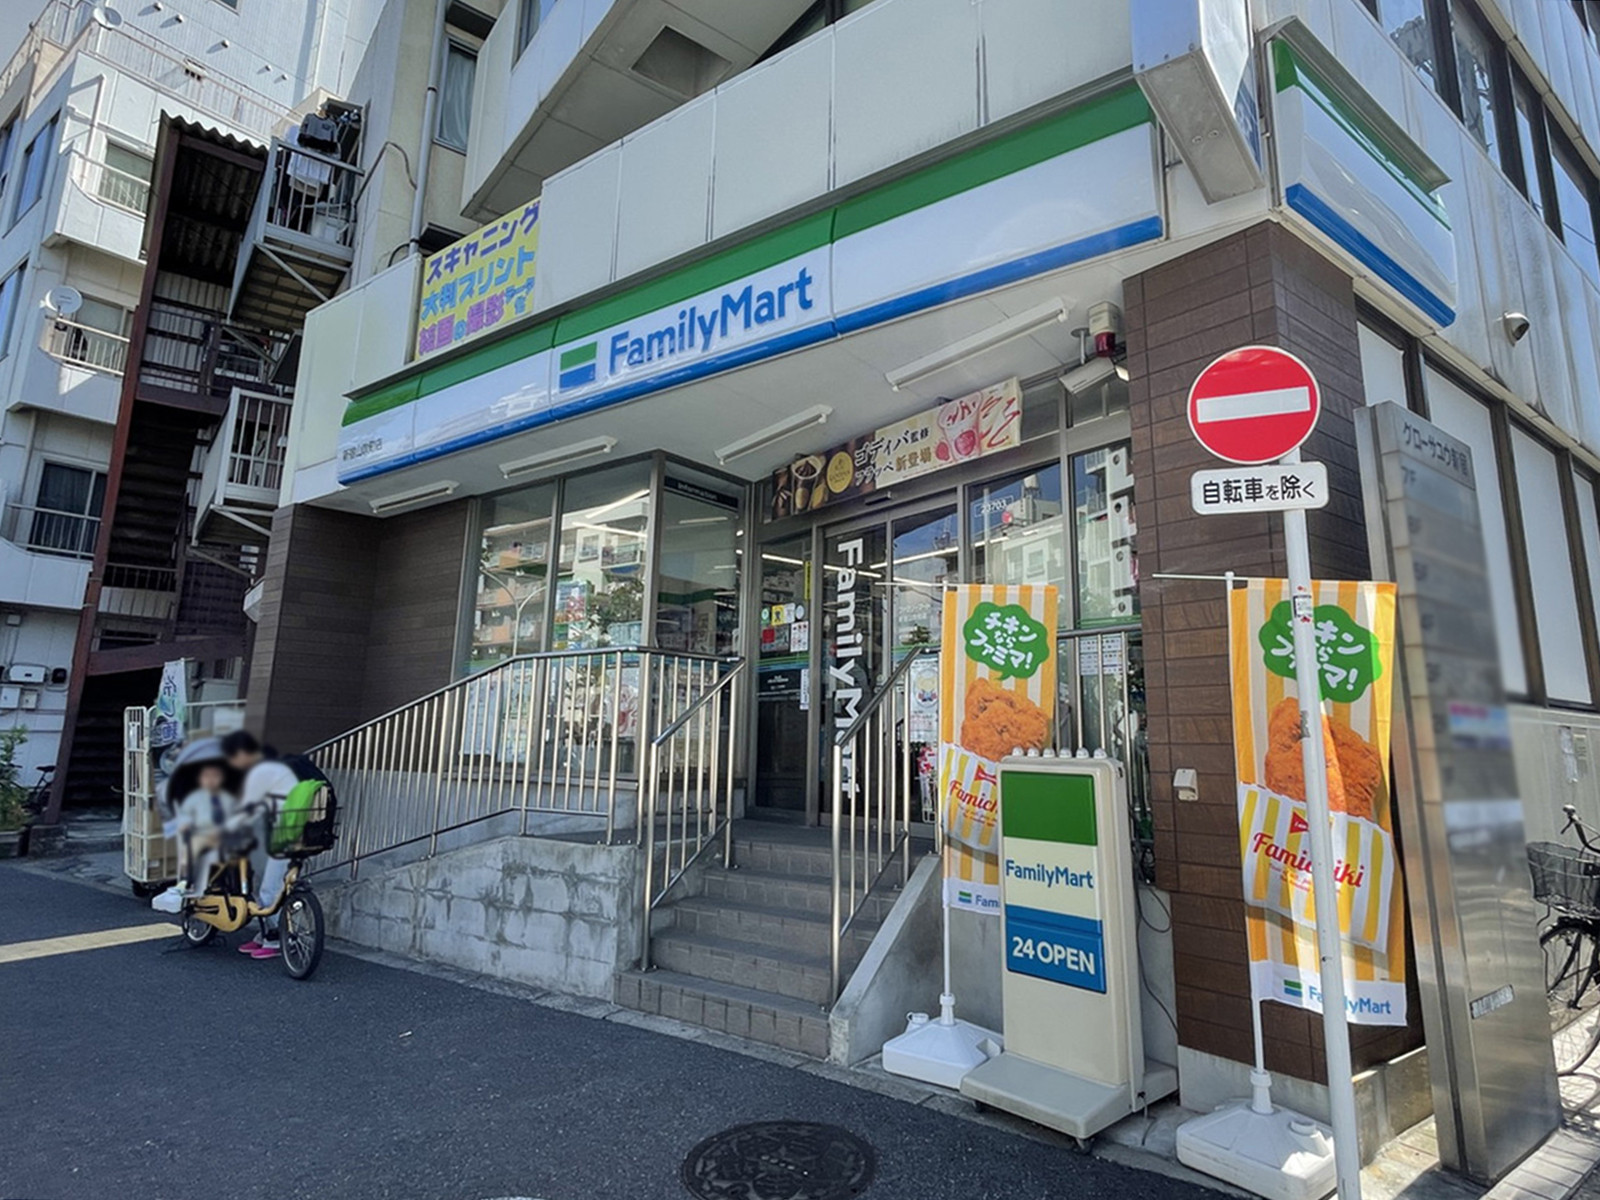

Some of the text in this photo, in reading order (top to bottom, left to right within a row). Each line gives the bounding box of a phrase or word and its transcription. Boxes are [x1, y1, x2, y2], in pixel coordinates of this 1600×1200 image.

[426, 200, 540, 285] スキャニング
[609, 267, 813, 375] FamilyMart
[1203, 475, 1315, 505] 自転車を除く
[984, 612, 1037, 643] チキン
[994, 630, 1017, 649] なら
[1287, 620, 1365, 655] キン
[970, 628, 1033, 669] ファミマ!
[1271, 635, 1358, 691] フマ!
[1006, 860, 1094, 889] FamilyMart
[1309, 985, 1391, 1015] FalyMart
